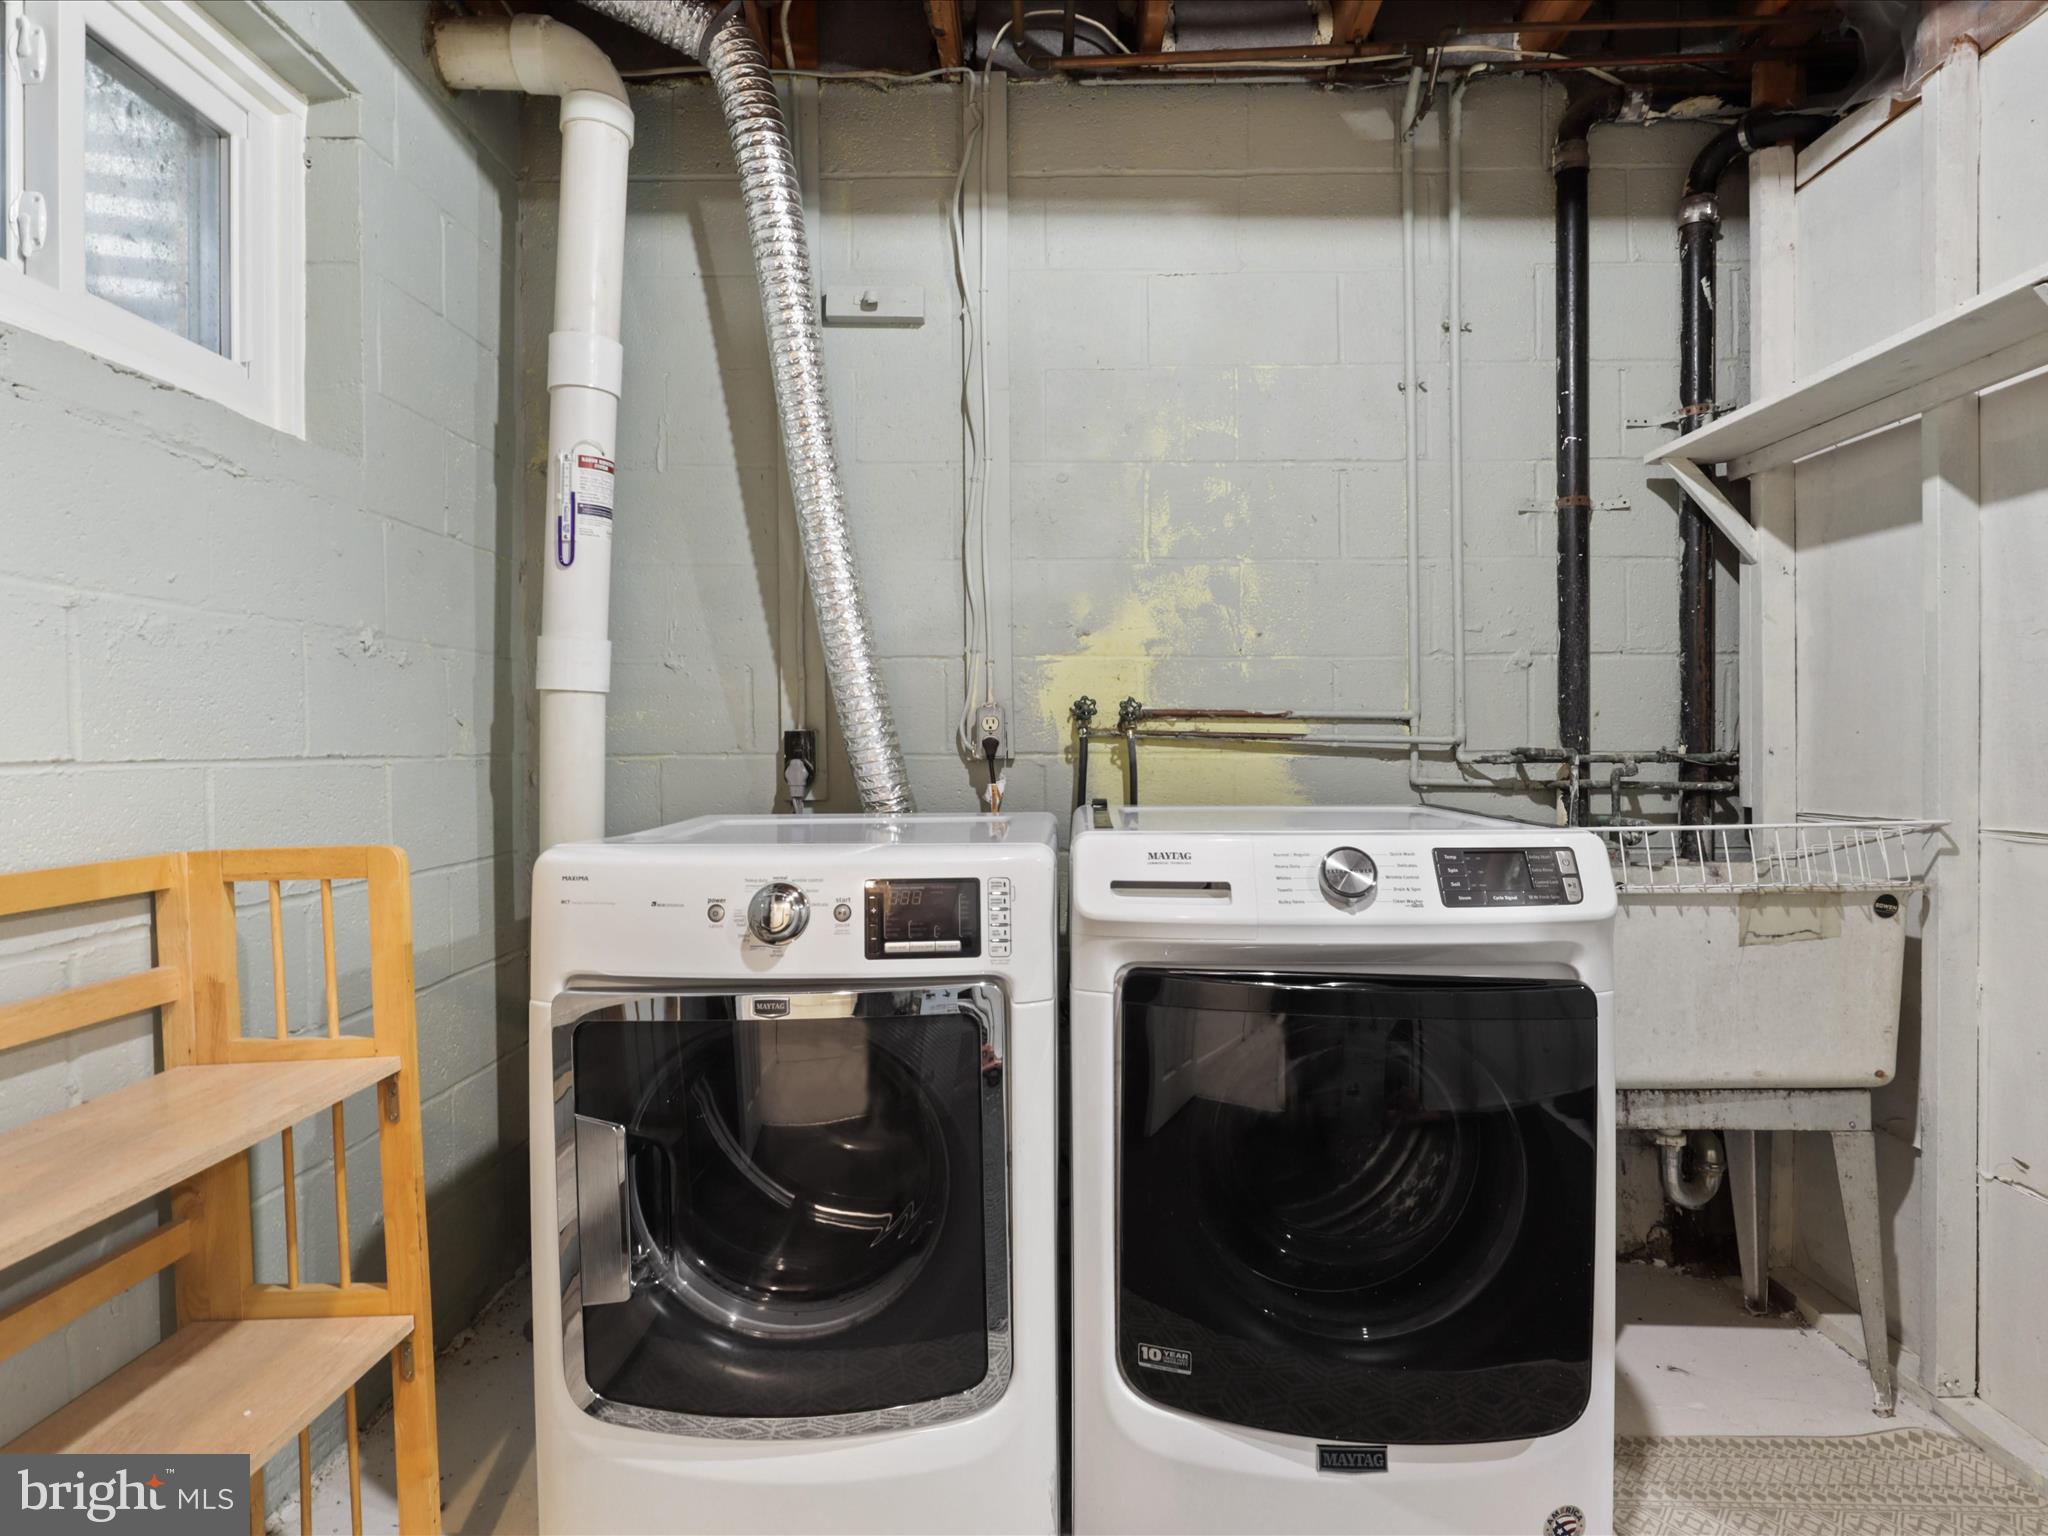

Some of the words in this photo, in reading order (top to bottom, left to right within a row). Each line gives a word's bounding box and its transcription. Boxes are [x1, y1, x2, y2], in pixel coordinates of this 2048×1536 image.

[1147, 851, 1192, 860] MAYTAG
[756, 1001, 786, 1011] MAYTAG
[1141, 1347, 1162, 1361] 10
[1162, 1350, 1189, 1360] YEAR
[1322, 1452, 1385, 1468] MAYTAG
